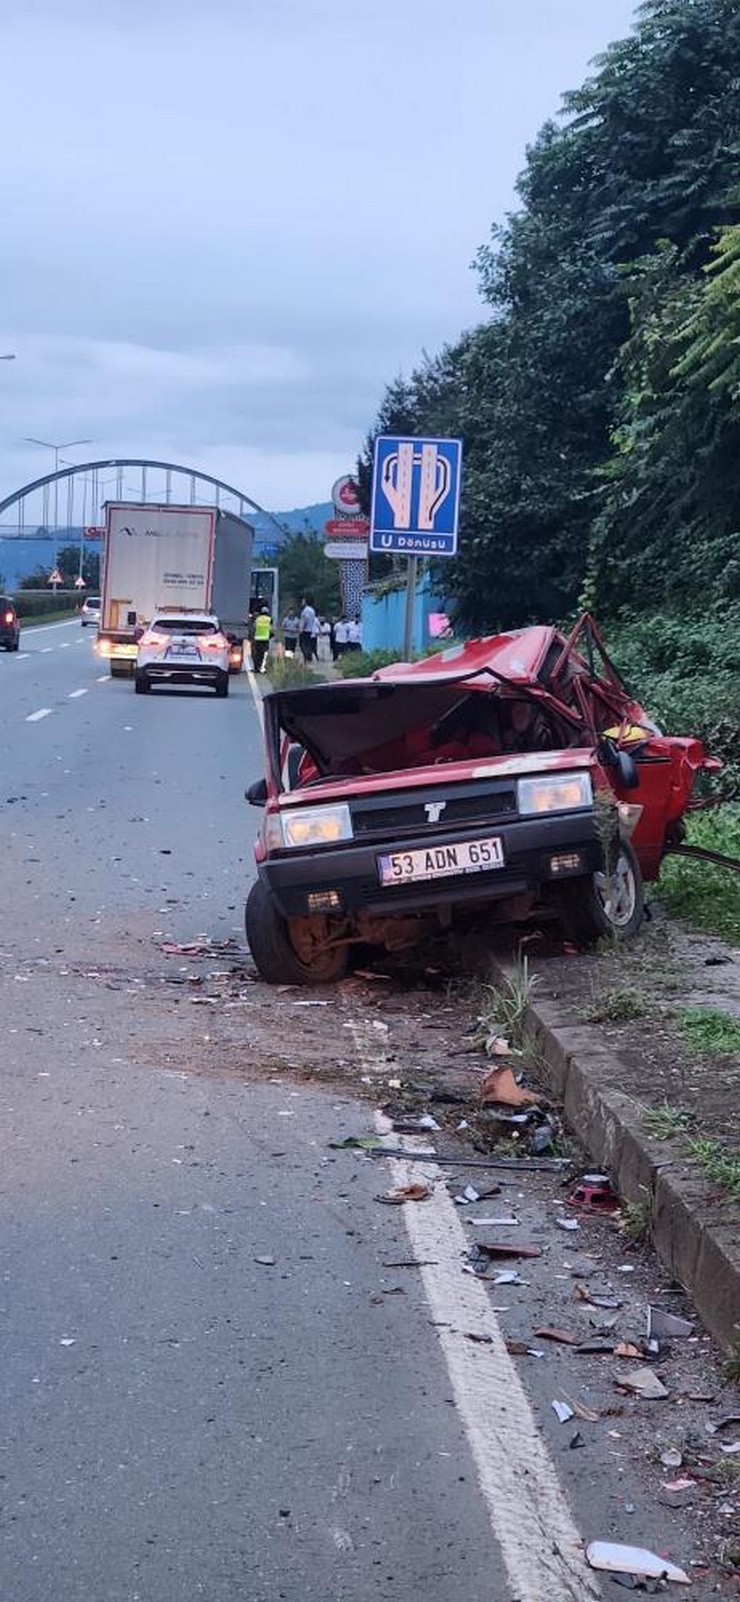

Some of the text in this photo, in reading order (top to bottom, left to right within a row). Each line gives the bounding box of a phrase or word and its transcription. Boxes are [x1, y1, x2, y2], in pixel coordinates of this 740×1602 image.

[381, 534, 393, 547] U
[391, 855, 414, 876] 53
[425, 847, 458, 871] ADN
[468, 841, 500, 864] 651
